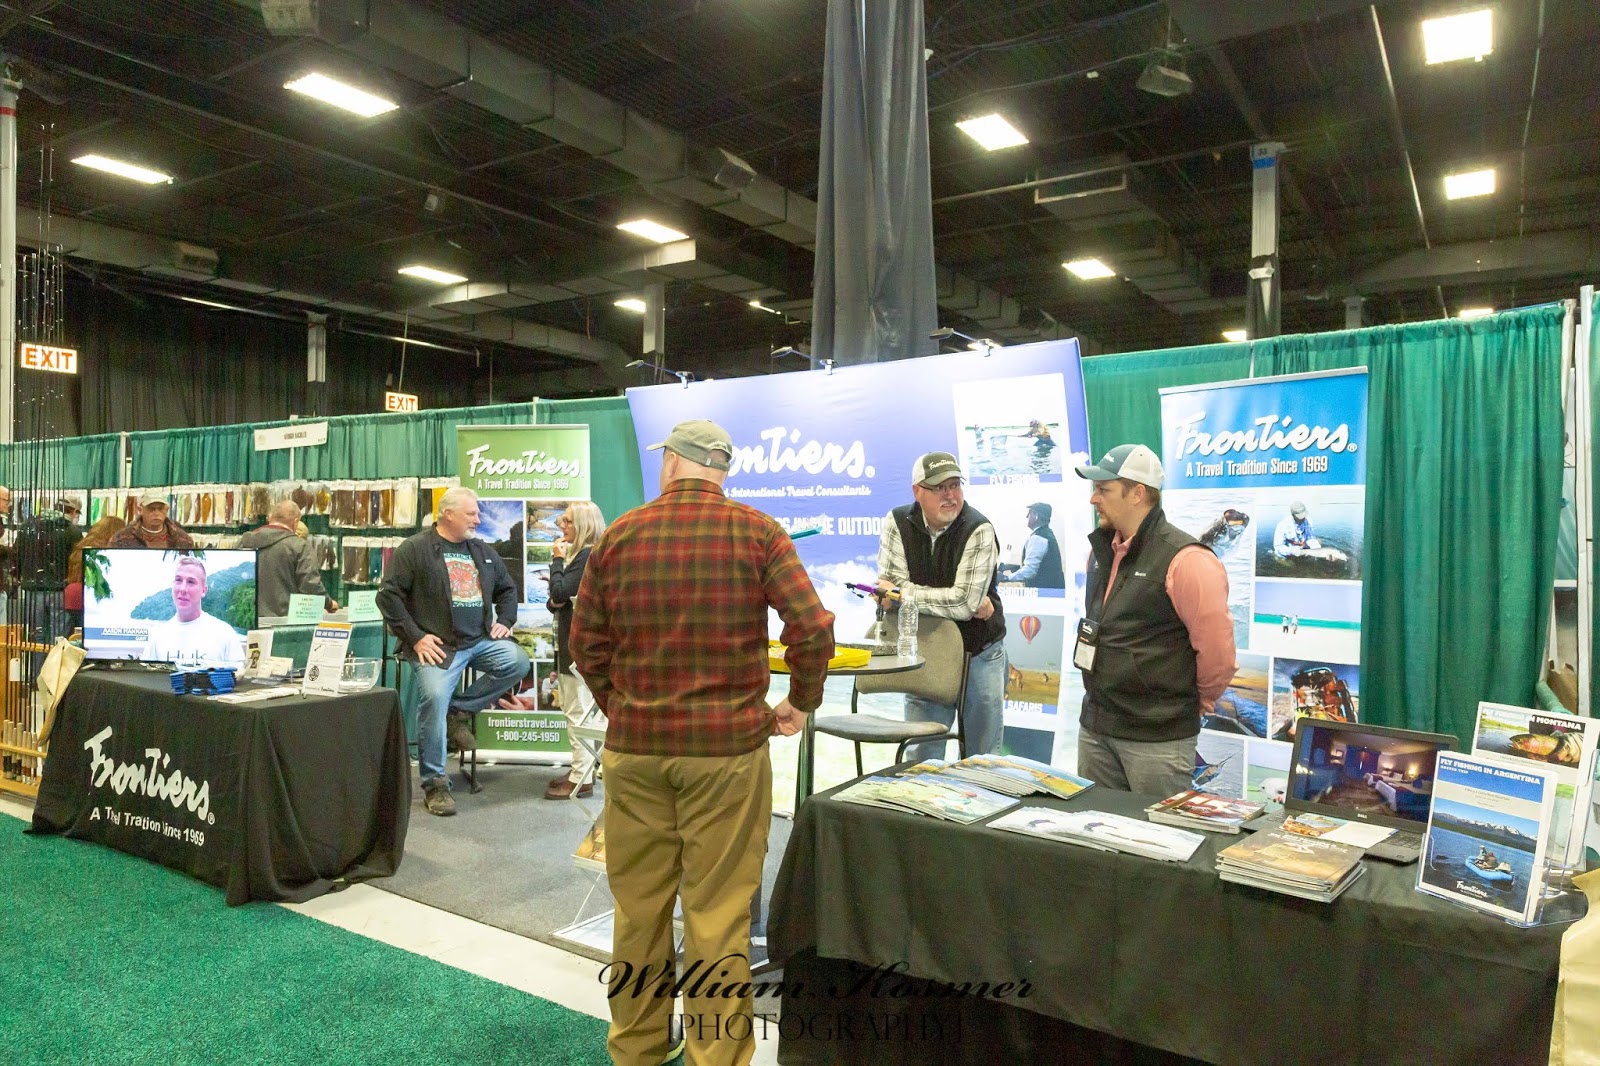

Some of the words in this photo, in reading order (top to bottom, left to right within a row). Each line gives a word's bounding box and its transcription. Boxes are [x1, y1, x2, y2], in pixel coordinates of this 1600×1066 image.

[25, 347, 73, 369] EXIT
[388, 395, 416, 411] EXIT
[1186, 462, 1194, 477] A
[1195, 460, 1223, 476] Travel
[1226, 459, 1267, 475] Tradition
[1270, 458, 1297, 474] Since
[1302, 456, 1328, 472] 1969
[477, 479, 483, 489] A
[484, 479, 503, 490] Travel
[505, 479, 532, 490] Tradition
[533, 479, 551, 490] Since
[553, 478, 569, 490] 1969
[730, 486, 786, 498] International
[786, 485, 815, 498] Travel
[815, 484, 872, 497] Consultants
[1008, 700, 1043, 714] SAFARIS
[488, 717, 567, 729] frontierstravel.com
[1536, 716, 1582, 730] MONTANA
[495, 731, 560, 743] 1-800-245-1950
[1440, 758, 1453, 766] FLY
[1453, 761, 1483, 773] FISHING
[1483, 767, 1493, 775] IN
[1493, 769, 1541, 785] ARGENTINA
[90, 807, 101, 820] A
[183, 828, 204, 846] 1969
